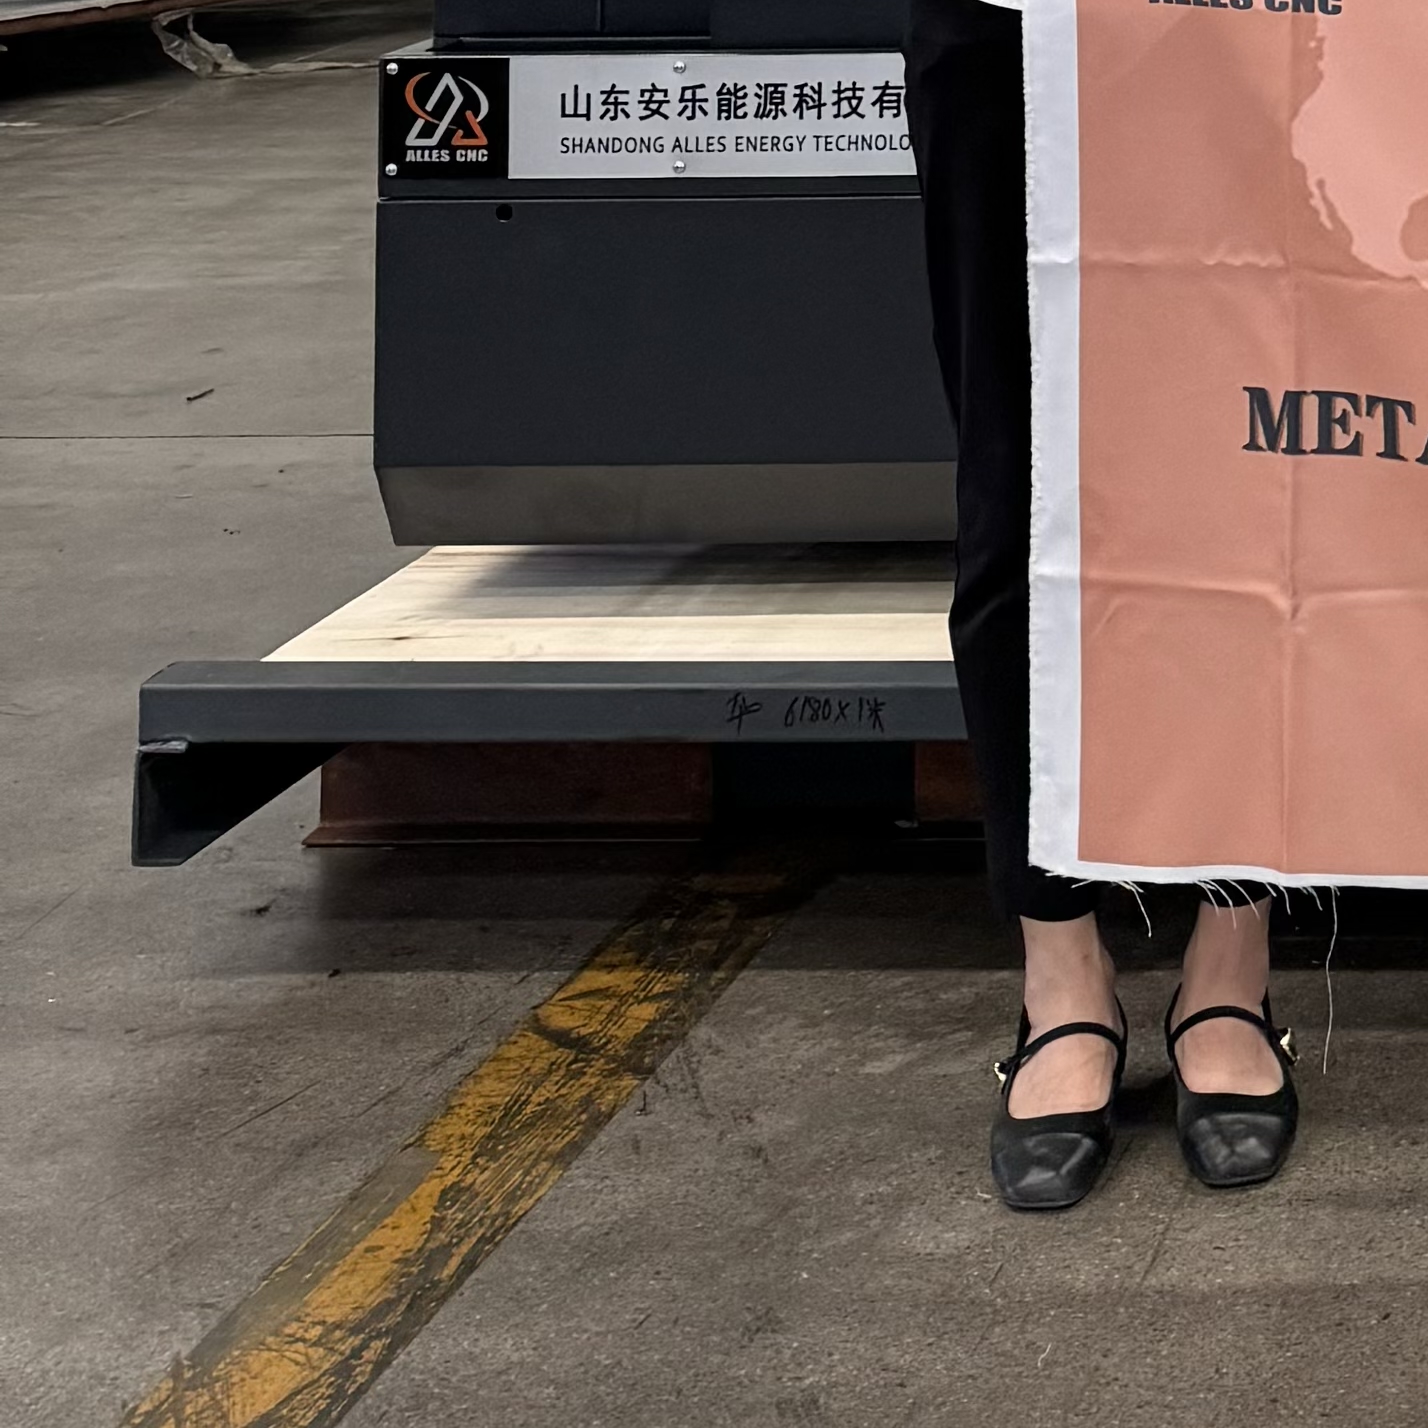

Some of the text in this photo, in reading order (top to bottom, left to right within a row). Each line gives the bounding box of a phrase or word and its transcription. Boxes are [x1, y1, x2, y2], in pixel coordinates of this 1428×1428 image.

[560, 80, 905, 121] 山东安乐能源科技有
[560, 136, 665, 154] SHANDONG
[671, 135, 727, 154] ALLES
[735, 134, 807, 153] ENERGY
[405, 149, 489, 162] ALLES CNC
